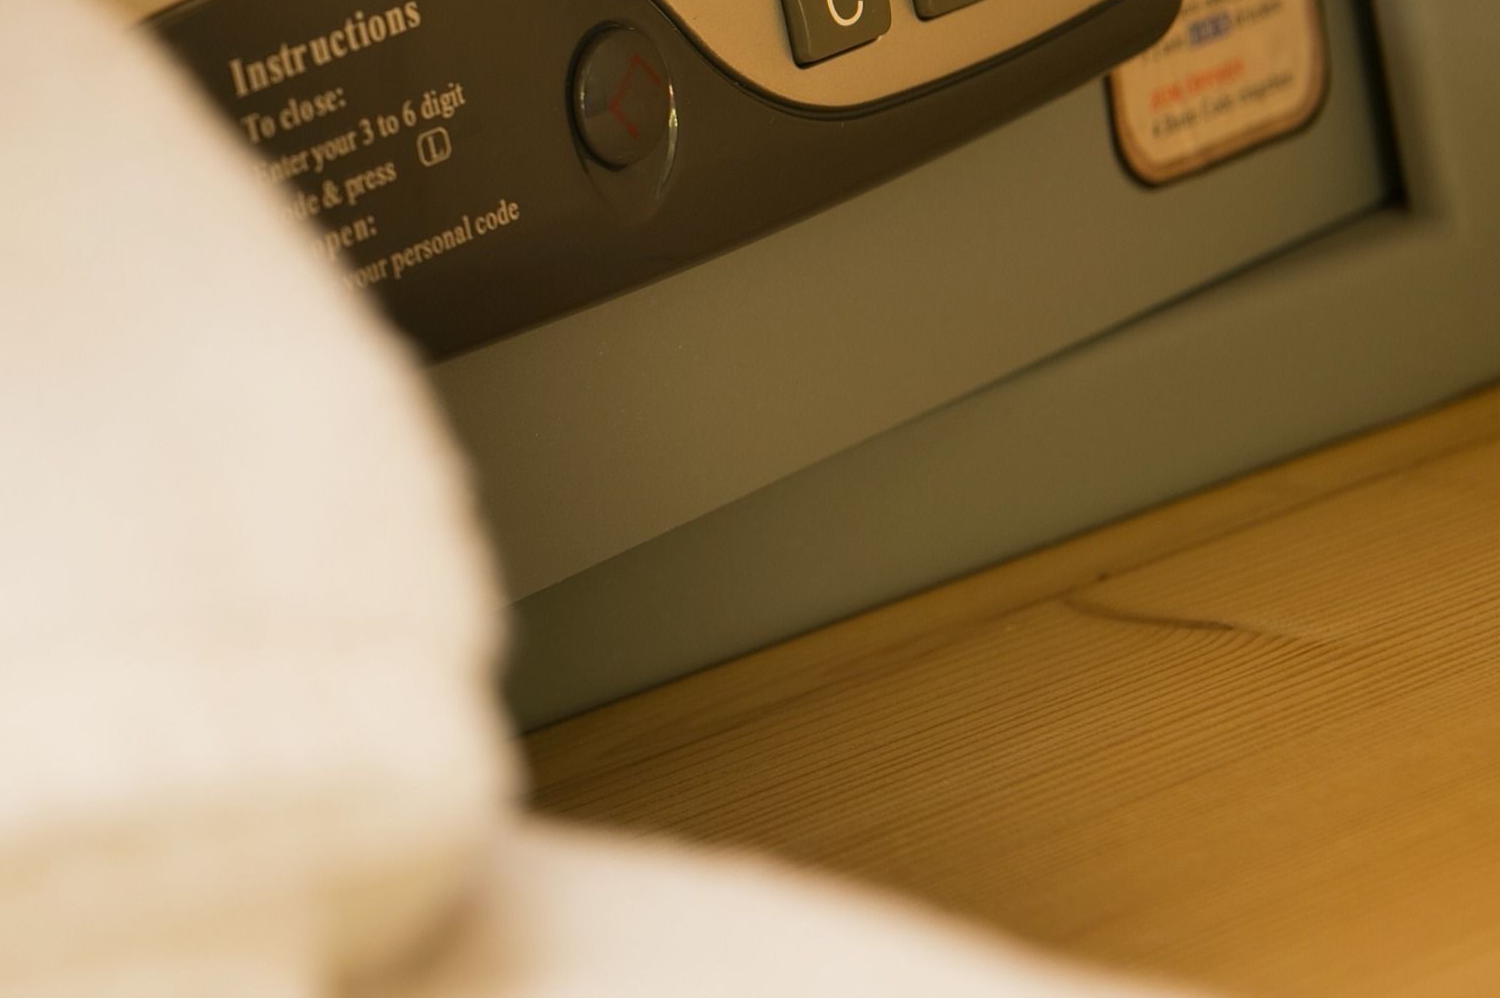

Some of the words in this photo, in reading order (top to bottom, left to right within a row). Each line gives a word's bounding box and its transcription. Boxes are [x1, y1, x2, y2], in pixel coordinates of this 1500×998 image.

[228, 0, 421, 97] Instructions
[241, 110, 276, 144] To
[280, 87, 347, 131] close:
[310, 132, 358, 173] your
[359, 118, 375, 146] 3
[377, 111, 399, 138] to
[402, 100, 417, 127] 6
[420, 82, 466, 120] digit
[321, 179, 343, 208] &
[344, 162, 397, 206] press
[392, 215, 473, 280] personal
[474, 199, 520, 236] code
